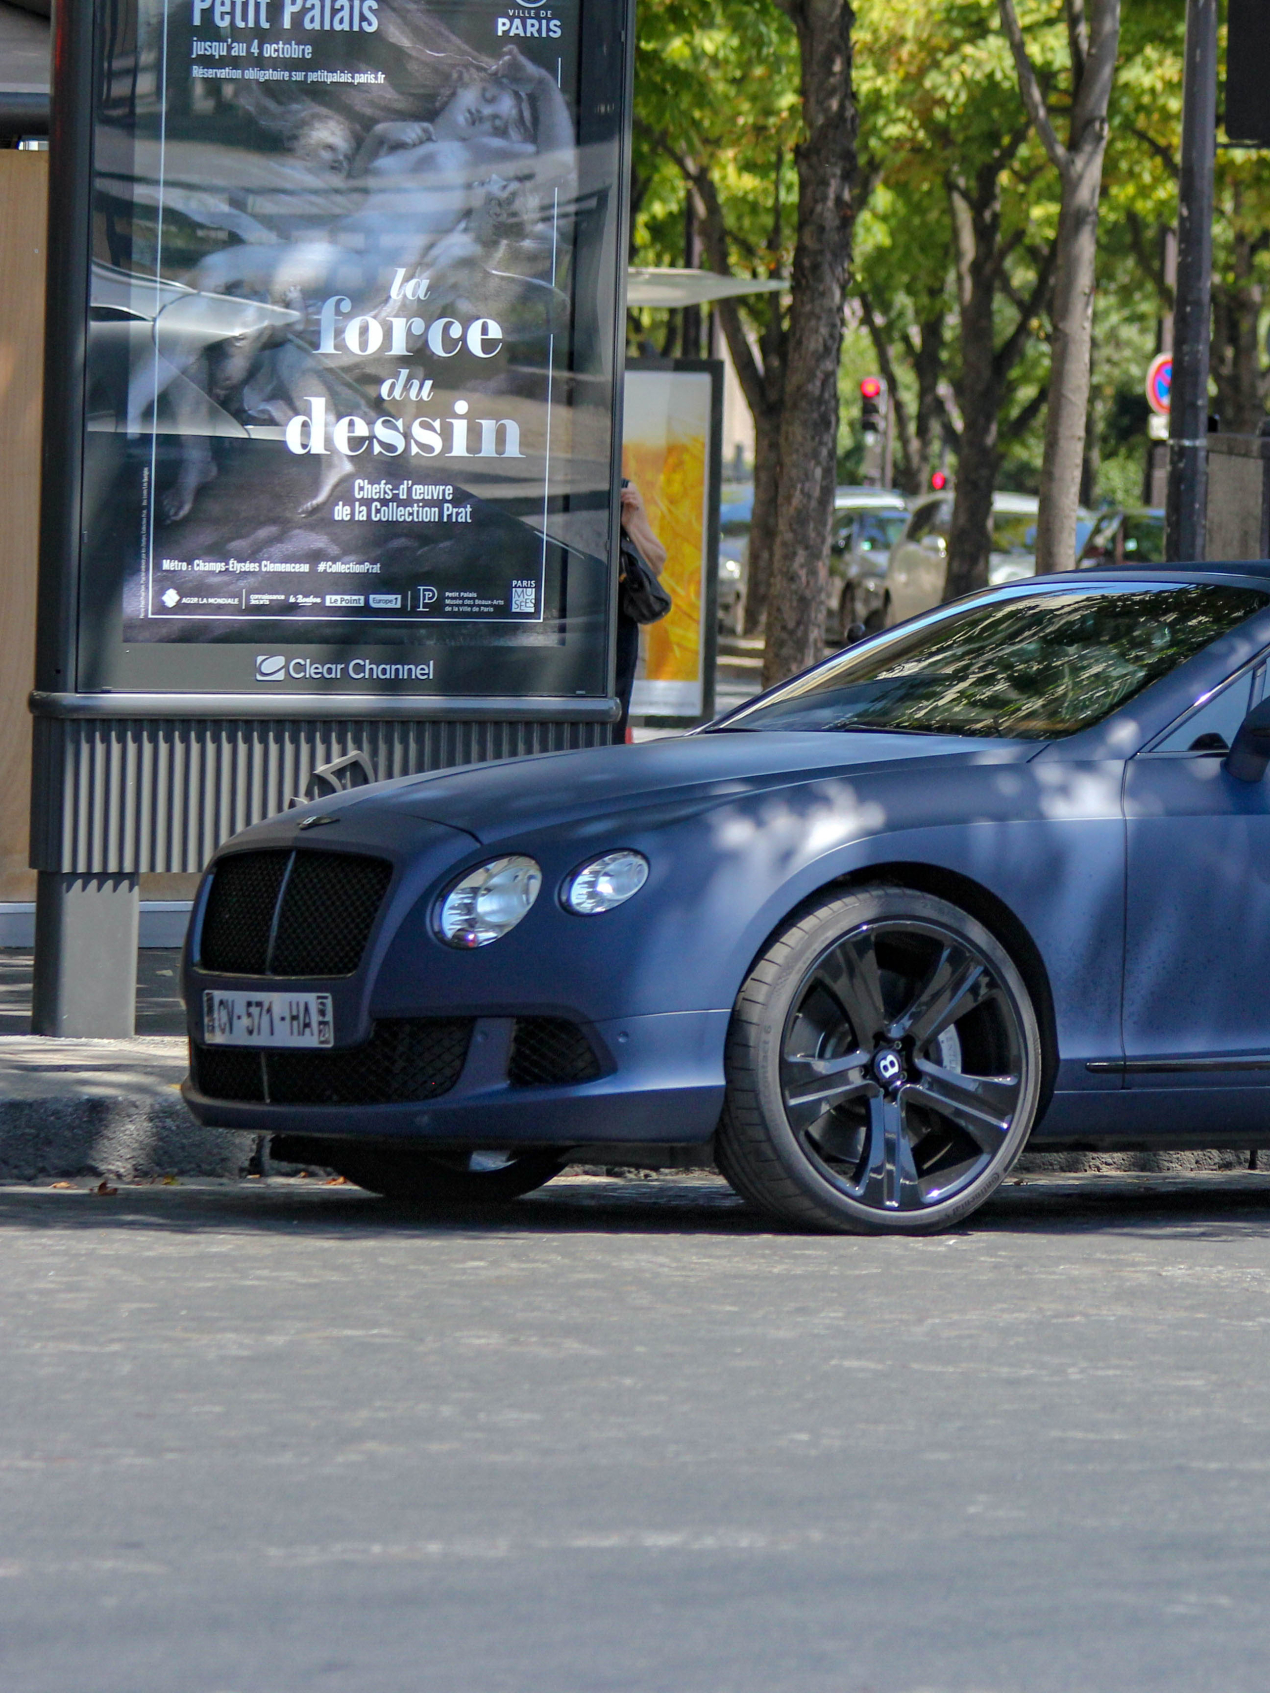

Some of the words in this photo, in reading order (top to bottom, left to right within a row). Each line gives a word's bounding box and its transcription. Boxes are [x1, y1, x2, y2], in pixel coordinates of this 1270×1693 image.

[192, 0, 271, 29] Petit
[283, 0, 379, 33] Palais
[508, 9, 536, 17] VILLE
[540, 10, 552, 18] DE
[497, 17, 562, 38] PARIS
[191, 37, 247, 59] jusqu'au
[250, 40, 260, 57] 4
[263, 41, 312, 59] octobre
[192, 65, 242, 79] Réservation
[244, 67, 289, 82] obligatoire
[291, 72, 306, 81] sur
[307, 70, 386, 85] petitpalais.paris.fr
[390, 268, 430, 301] la
[312, 295, 503, 358] force
[380, 368, 434, 401] du
[285, 397, 526, 458] dessin
[354, 479, 453, 500] Chefs-d'œuvre
[334, 501, 351, 521] de
[354, 502, 367, 521] la
[371, 502, 439, 522] Collection
[443, 503, 472, 523] Prat
[193, 558, 259, 574] Champs-Élysées
[261, 560, 310, 572] Clemenceau
[317, 561, 382, 573] #CollectionPrat
[512, 580, 536, 588] PARIS
[340, 597, 362, 605] Point
[288, 658, 345, 679] Clear
[348, 659, 434, 680] Channel
